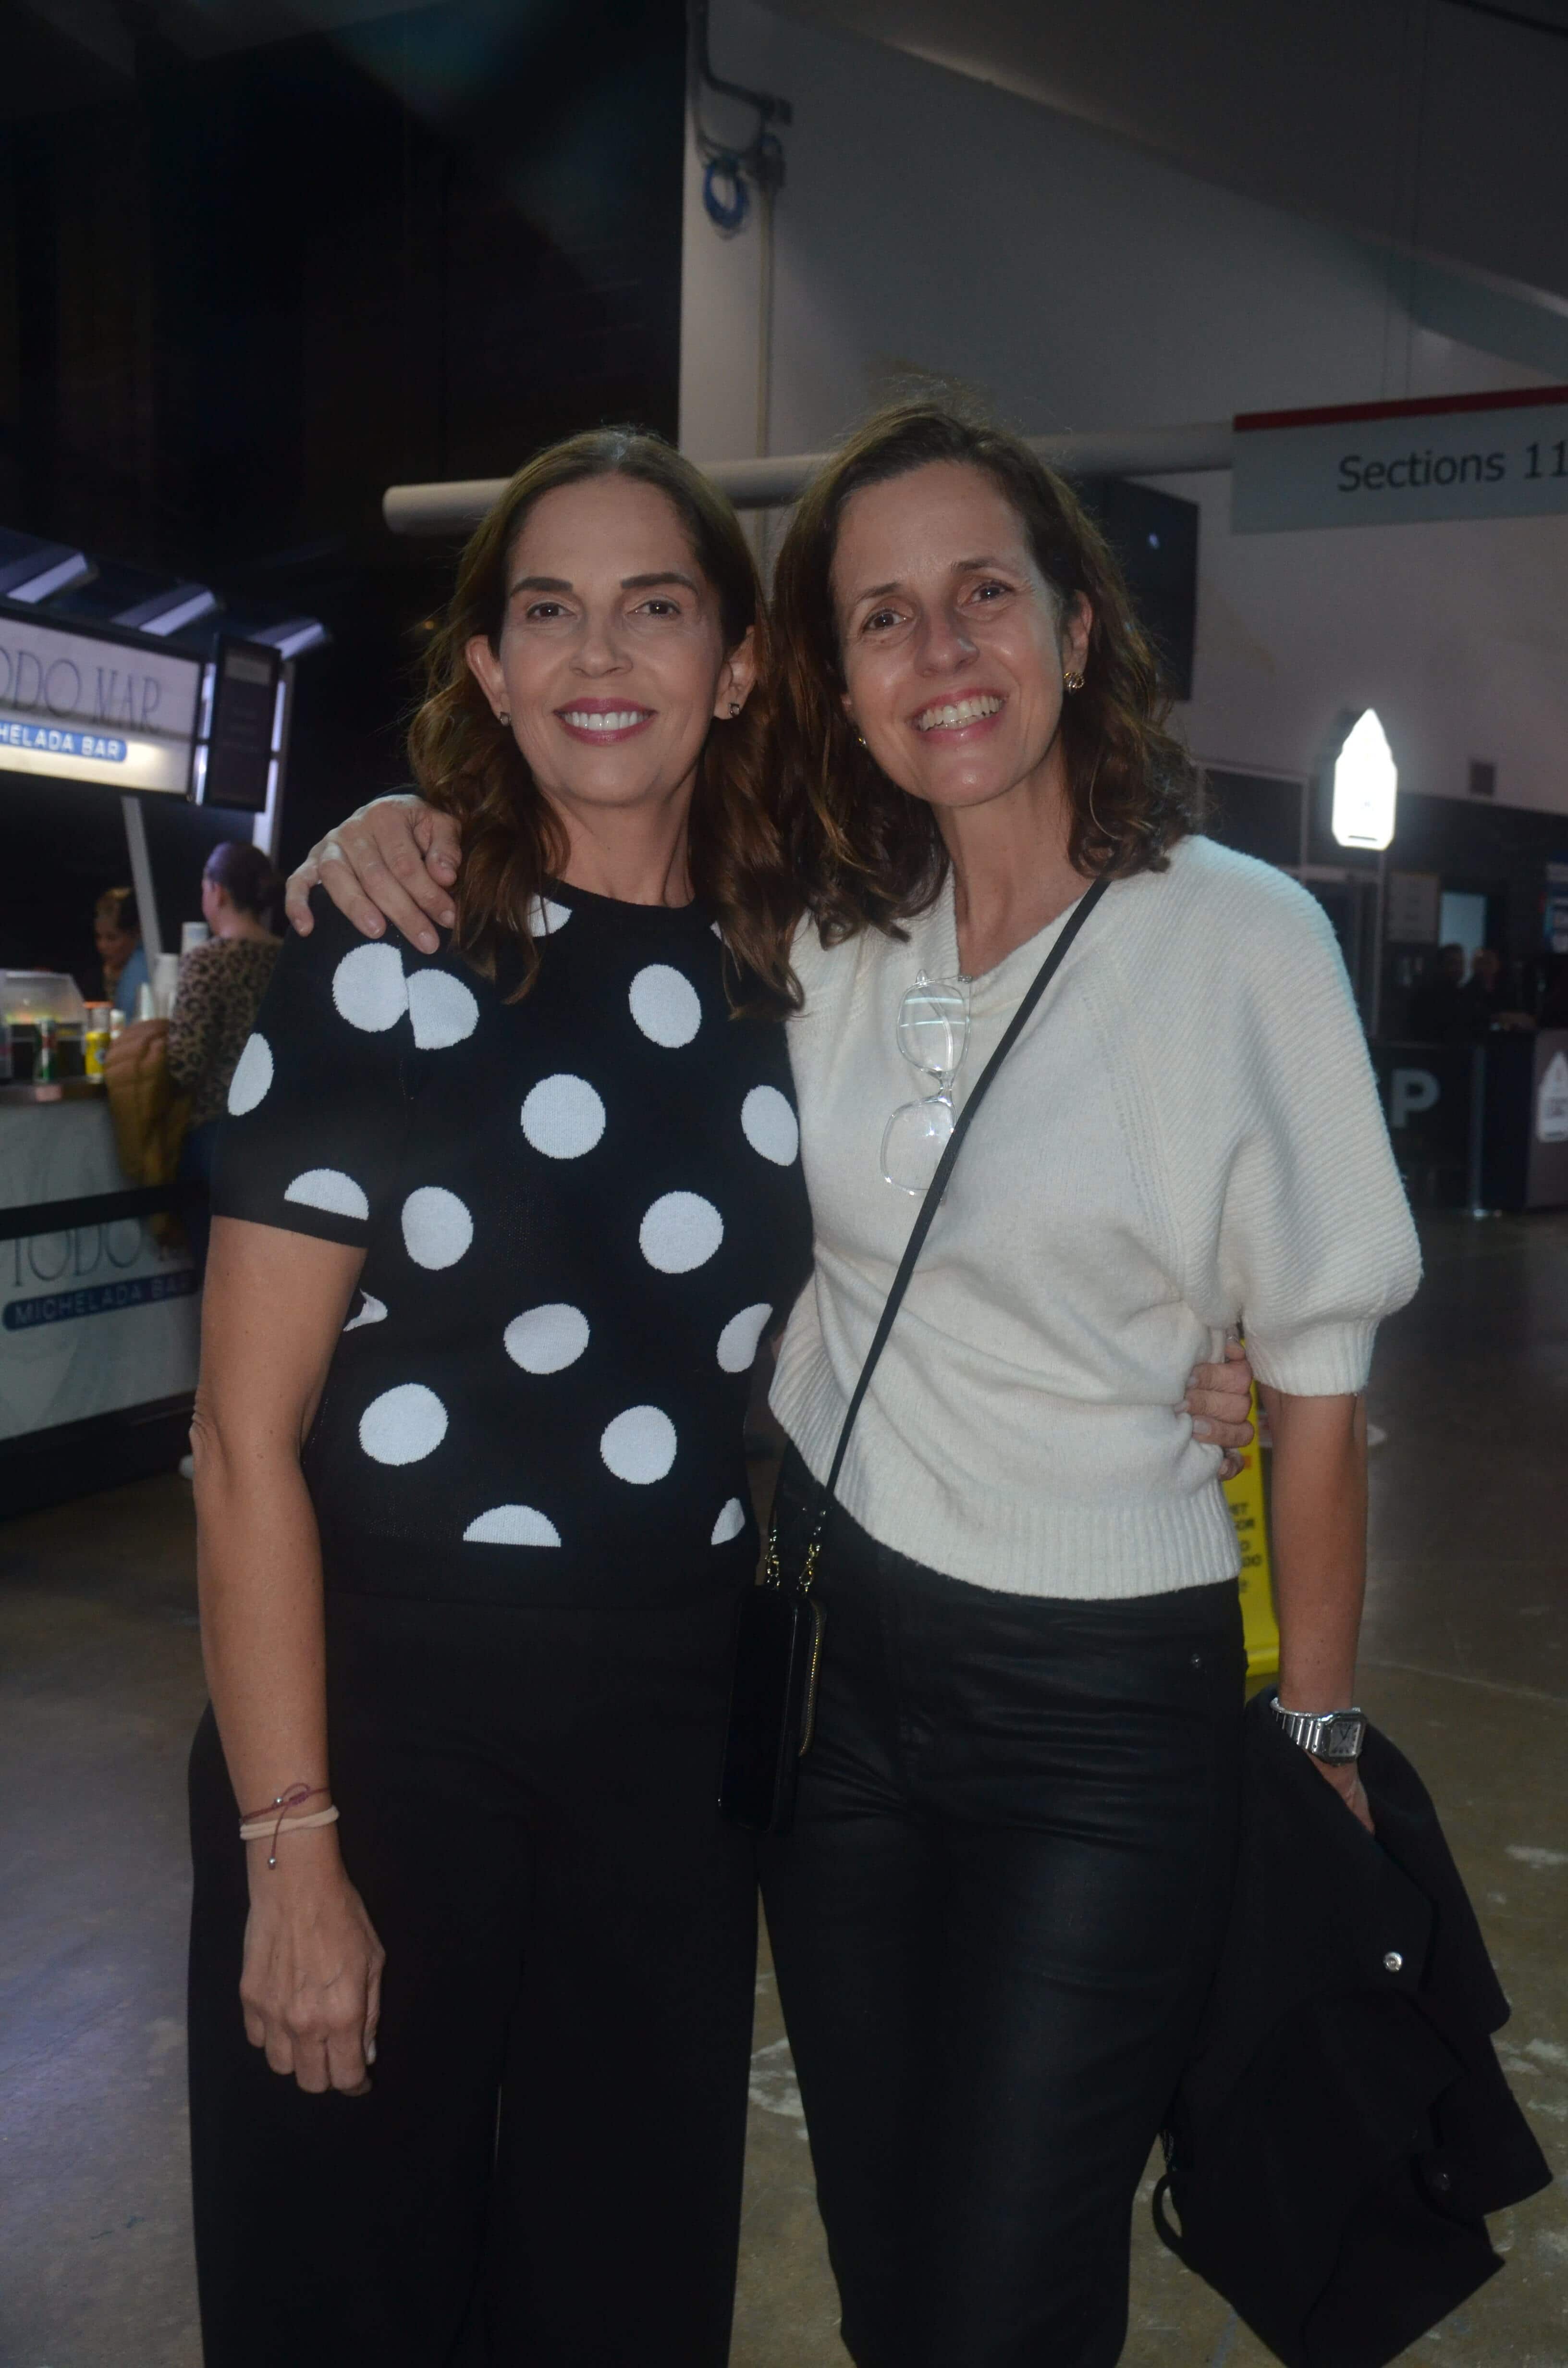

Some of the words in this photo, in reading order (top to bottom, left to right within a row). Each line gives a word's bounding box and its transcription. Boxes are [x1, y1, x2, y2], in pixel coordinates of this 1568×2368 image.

[1338, 447, 1506, 492] Sections
[1524, 440, 1568, 479] 11
[81, 735, 120, 760] BAR
[14, 1284, 143, 1323] MICHELADA
